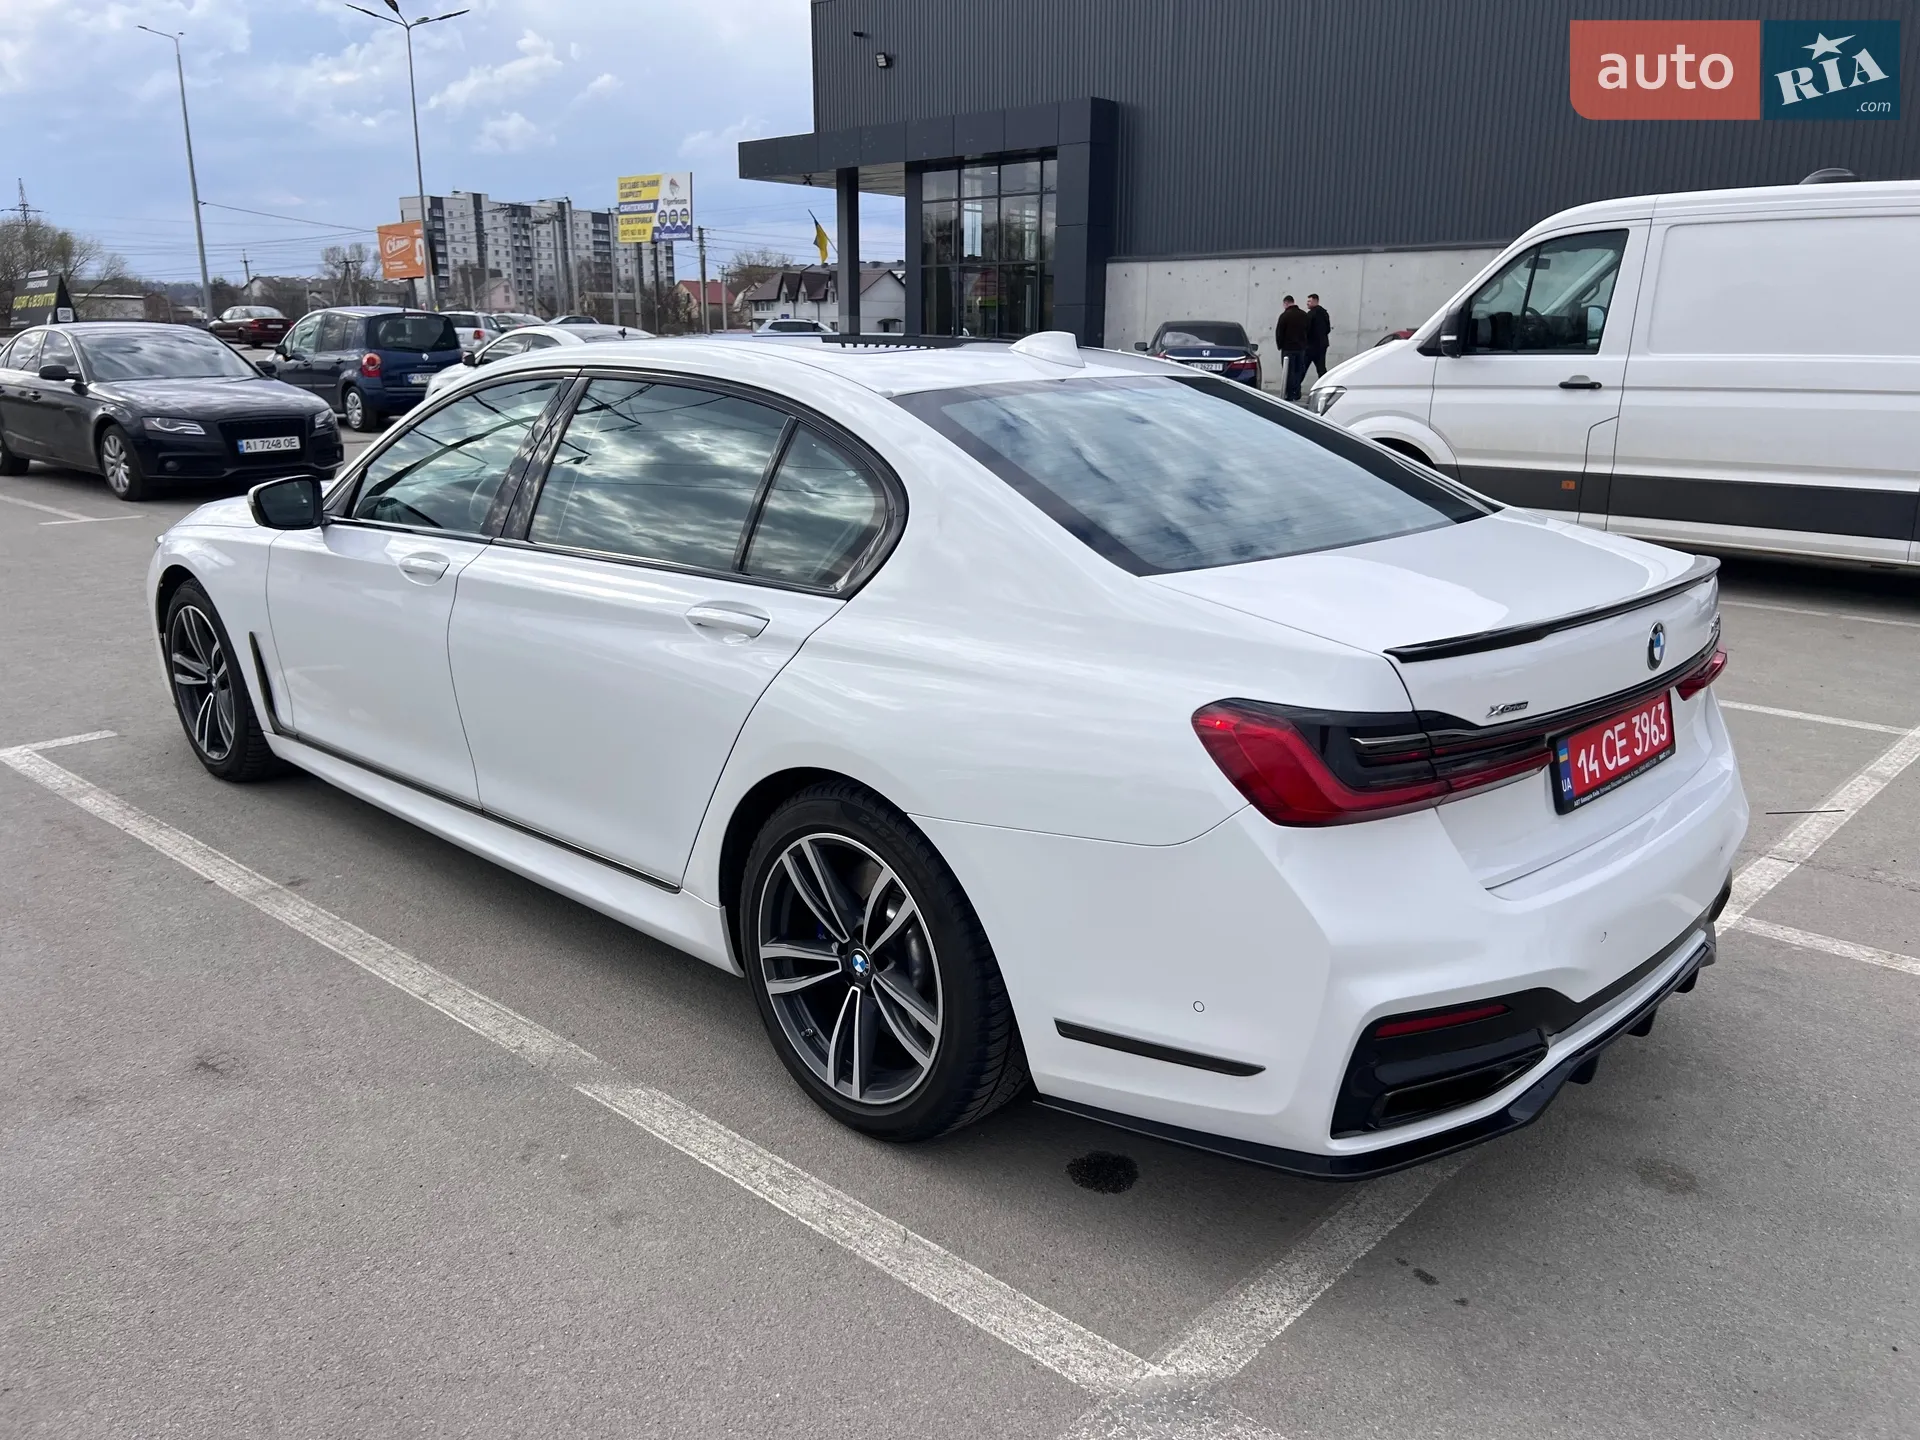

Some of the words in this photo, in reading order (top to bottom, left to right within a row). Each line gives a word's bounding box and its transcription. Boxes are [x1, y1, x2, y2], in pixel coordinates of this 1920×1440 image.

[260, 439, 281, 450] 7248
[283, 437, 297, 448] OE
[1577, 744, 1600, 784] 14
[1602, 722, 1630, 771] CE
[1632, 702, 1667, 756] 3963
[1561, 777, 1573, 792] UA
